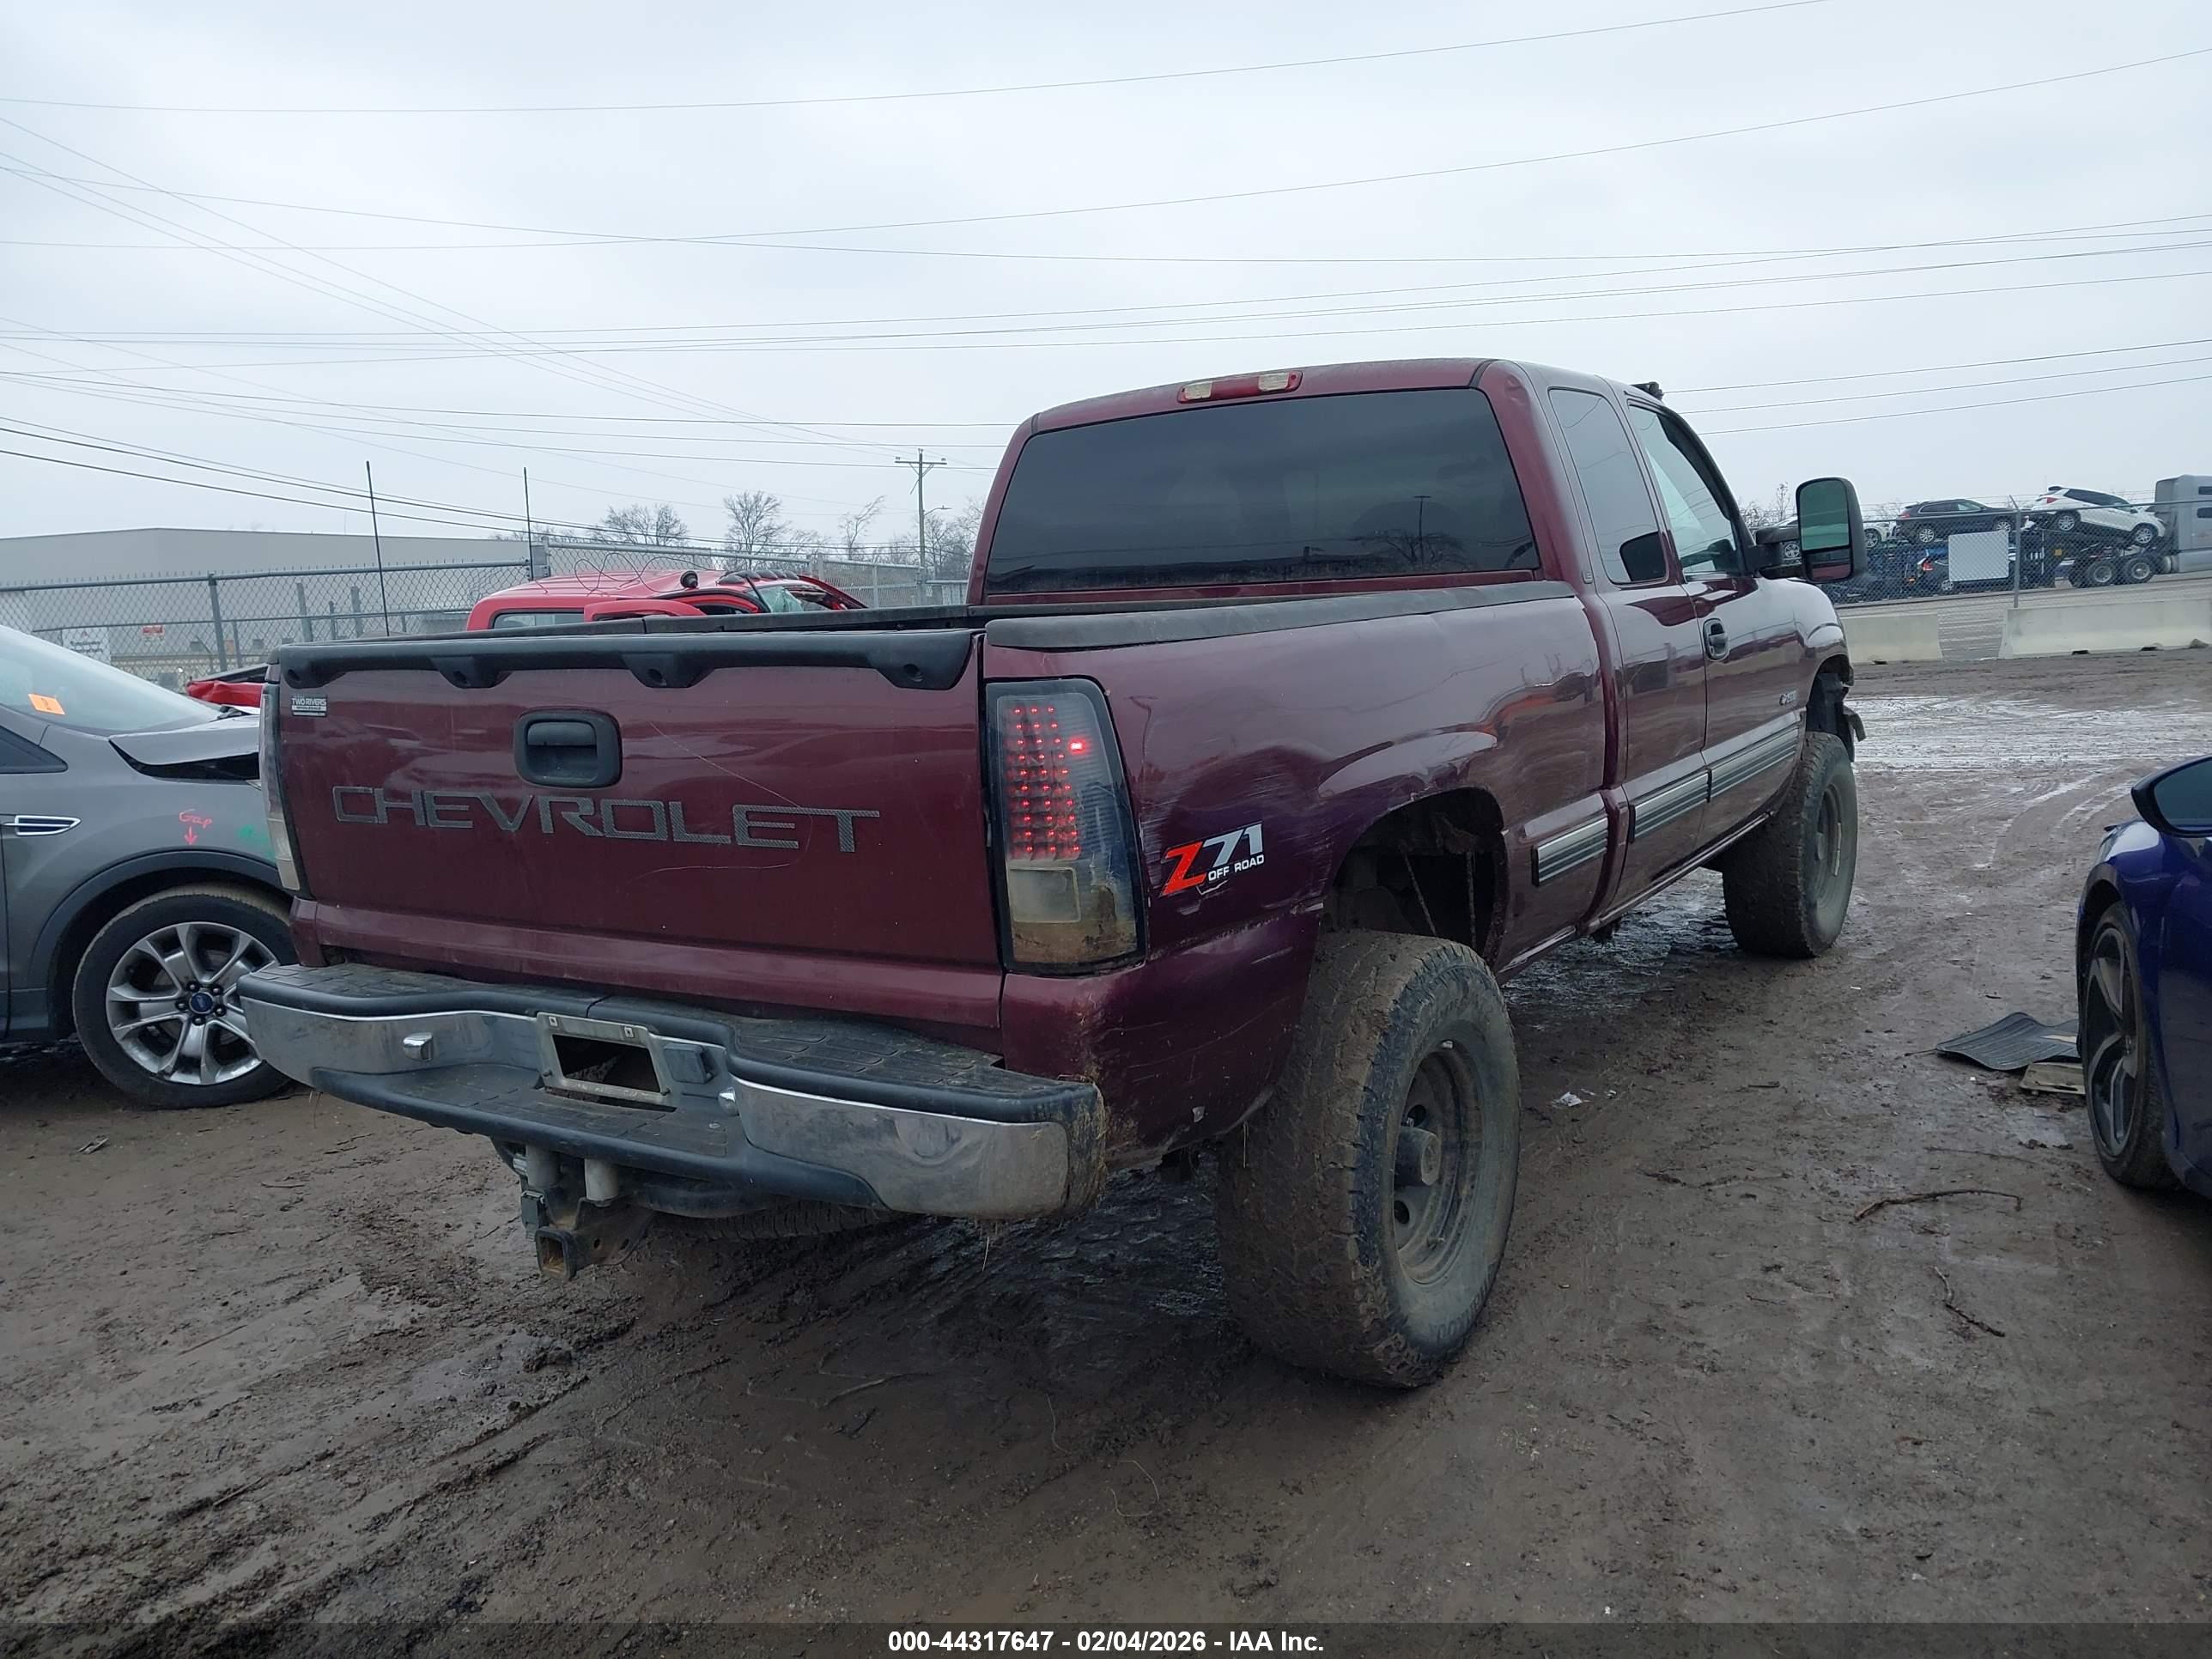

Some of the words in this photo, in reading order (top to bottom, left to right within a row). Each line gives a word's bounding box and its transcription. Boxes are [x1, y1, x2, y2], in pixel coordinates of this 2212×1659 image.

[292, 697, 306, 706] TWO
[306, 697, 327, 706] RIVERS
[332, 786, 880, 853] CHEVROLET
[1161, 823, 1264, 897] Z71
[1207, 866, 1231, 882] OFF
[1234, 854, 1265, 873] ROAD
